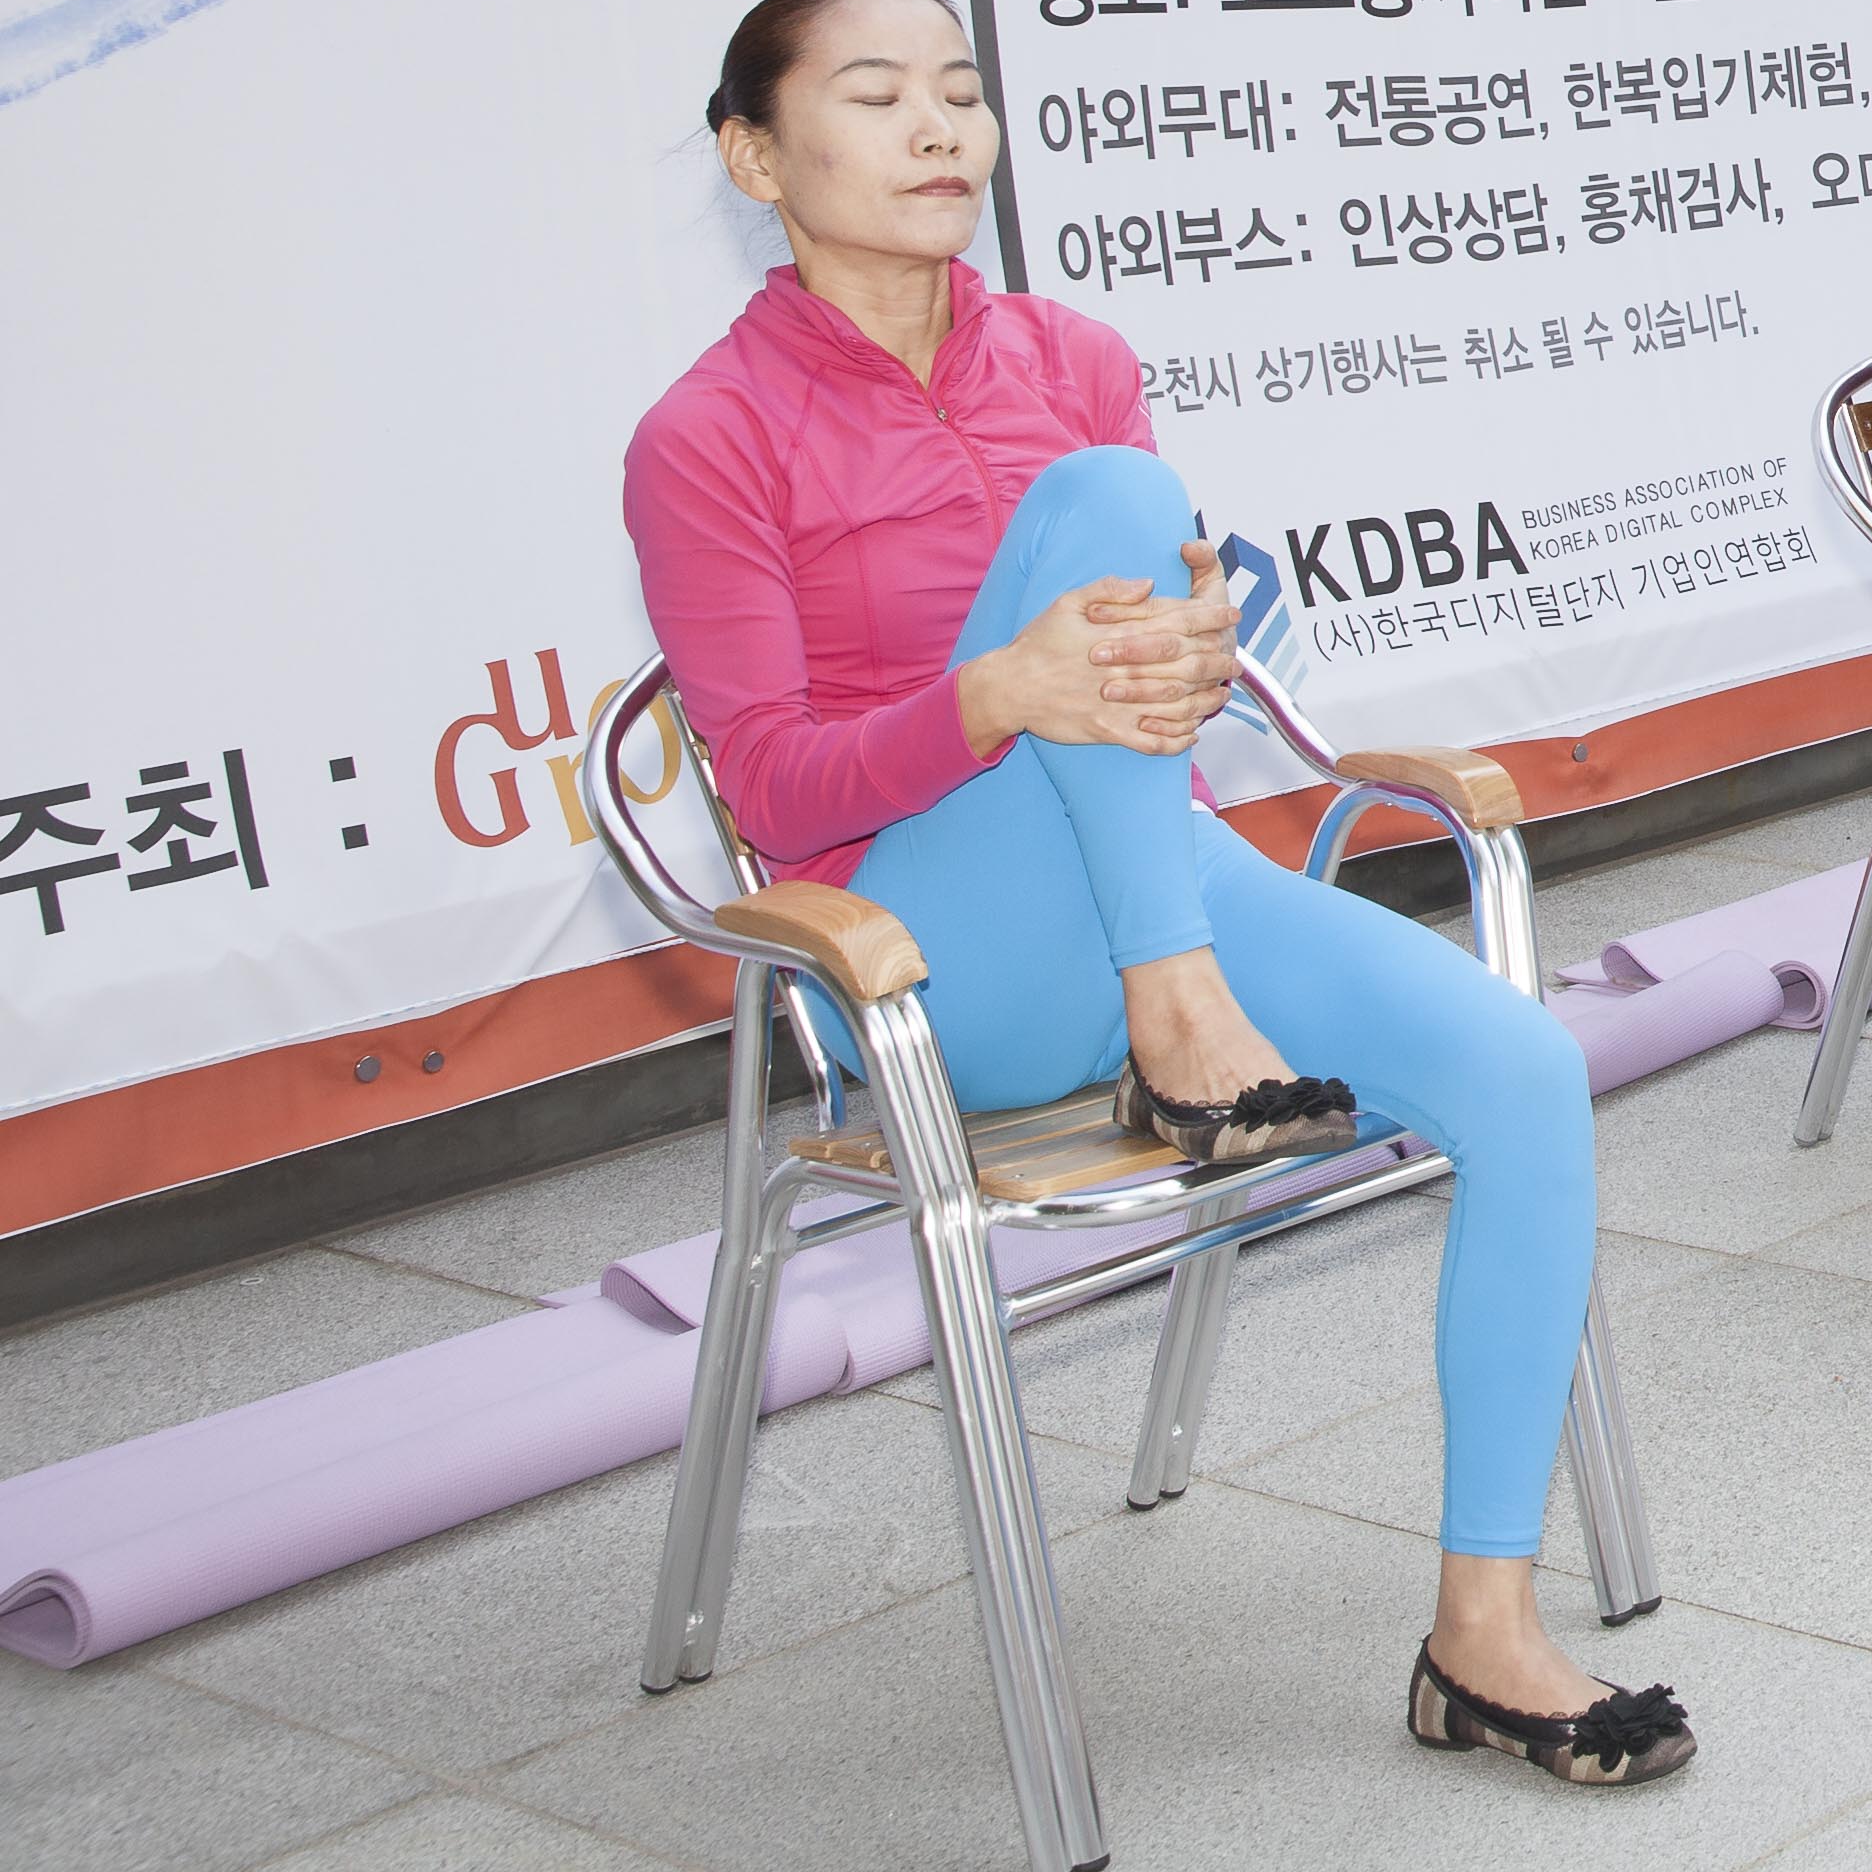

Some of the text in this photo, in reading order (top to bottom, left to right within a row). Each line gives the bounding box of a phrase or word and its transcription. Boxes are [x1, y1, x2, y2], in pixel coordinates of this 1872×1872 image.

[1037, 78, 1298, 164] 야외무대:
[1323, 67, 1550, 150] 전통공연,
[1561, 39, 1870, 132] 한복입기체험,
[1056, 203, 1313, 294] 야외부스:
[1337, 182, 1567, 269] 인상상담,
[1578, 156, 1785, 247] 홍채검사,
[1256, 332, 1449, 405] 상기행사는
[1463, 326, 1534, 380] 취소
[1540, 315, 1575, 370] 될
[1583, 310, 1614, 362] 수
[1623, 289, 1760, 356] 있습니다.
[1521, 456, 1788, 529] BUSINESS ASSOCIATION OF
[1528, 487, 1789, 561] KOREA DIGITAL COMPLEX
[1286, 500, 1532, 608] KDBA
[1313, 525, 1818, 663] (사)한국디지털단지 기업인연합회
